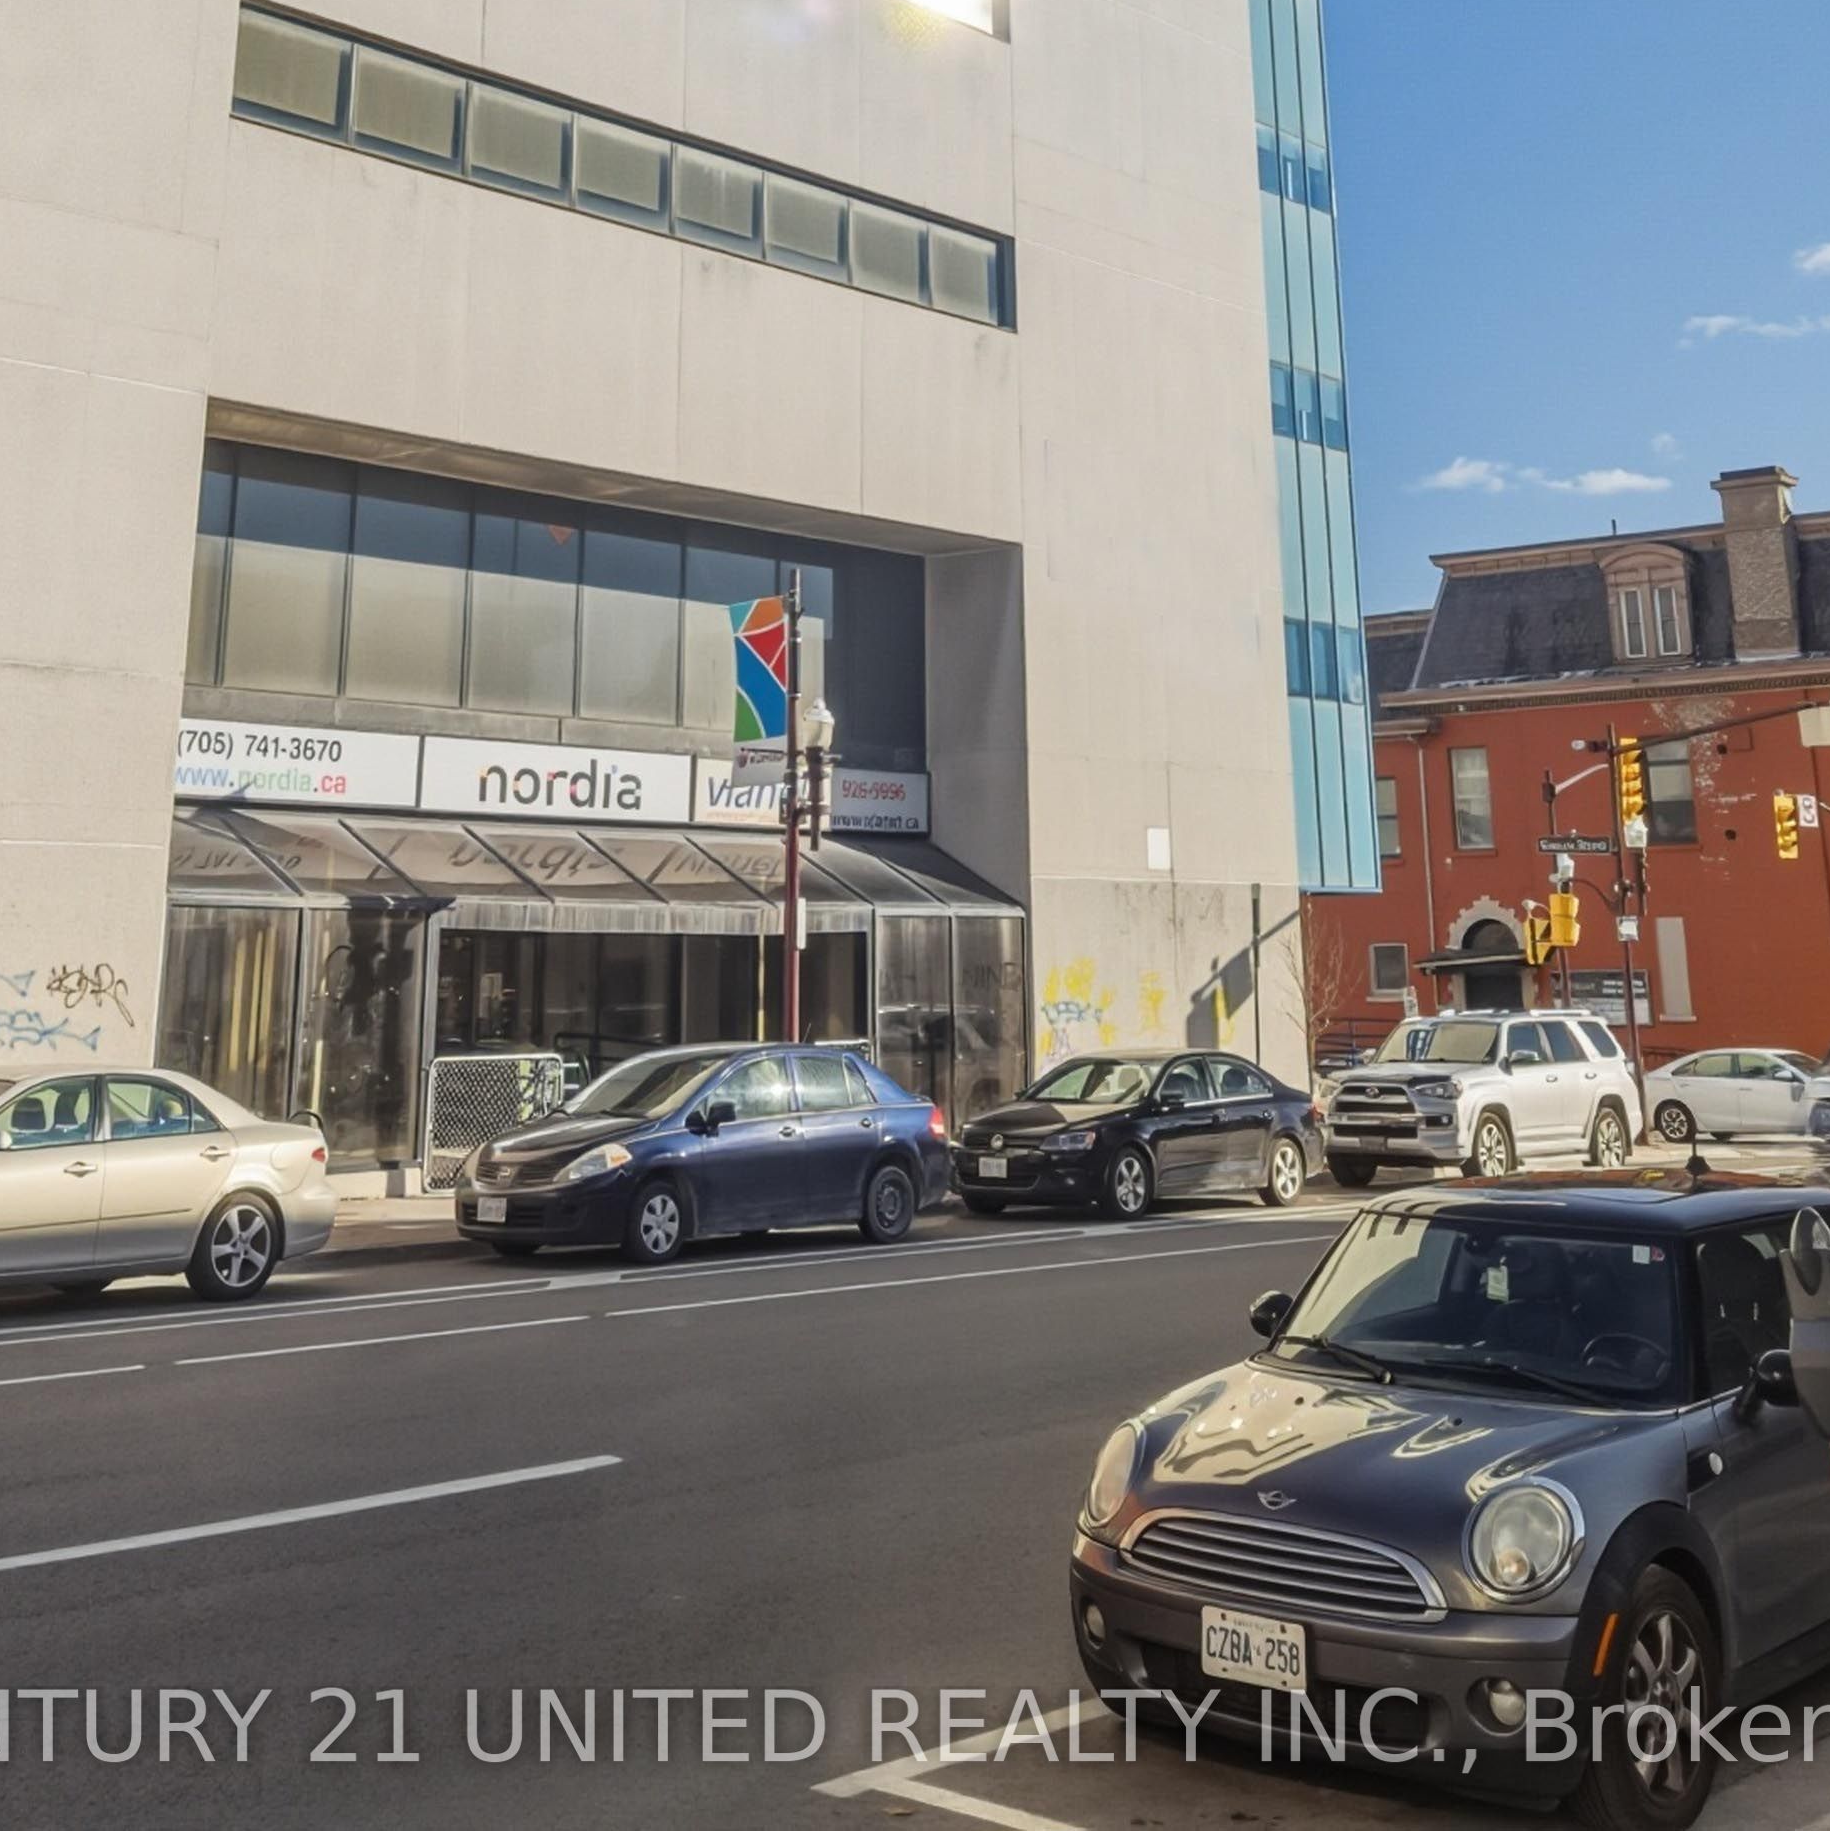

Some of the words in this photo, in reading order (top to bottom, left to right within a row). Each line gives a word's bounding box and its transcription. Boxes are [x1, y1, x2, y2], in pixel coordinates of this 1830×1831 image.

[177, 730, 235, 760] (705)
[244, 733, 343, 763] 741-3670
[478, 758, 643, 810] nordia
[1206, 1625, 1253, 1666] CZBA
[1265, 1637, 1301, 1677] 258
